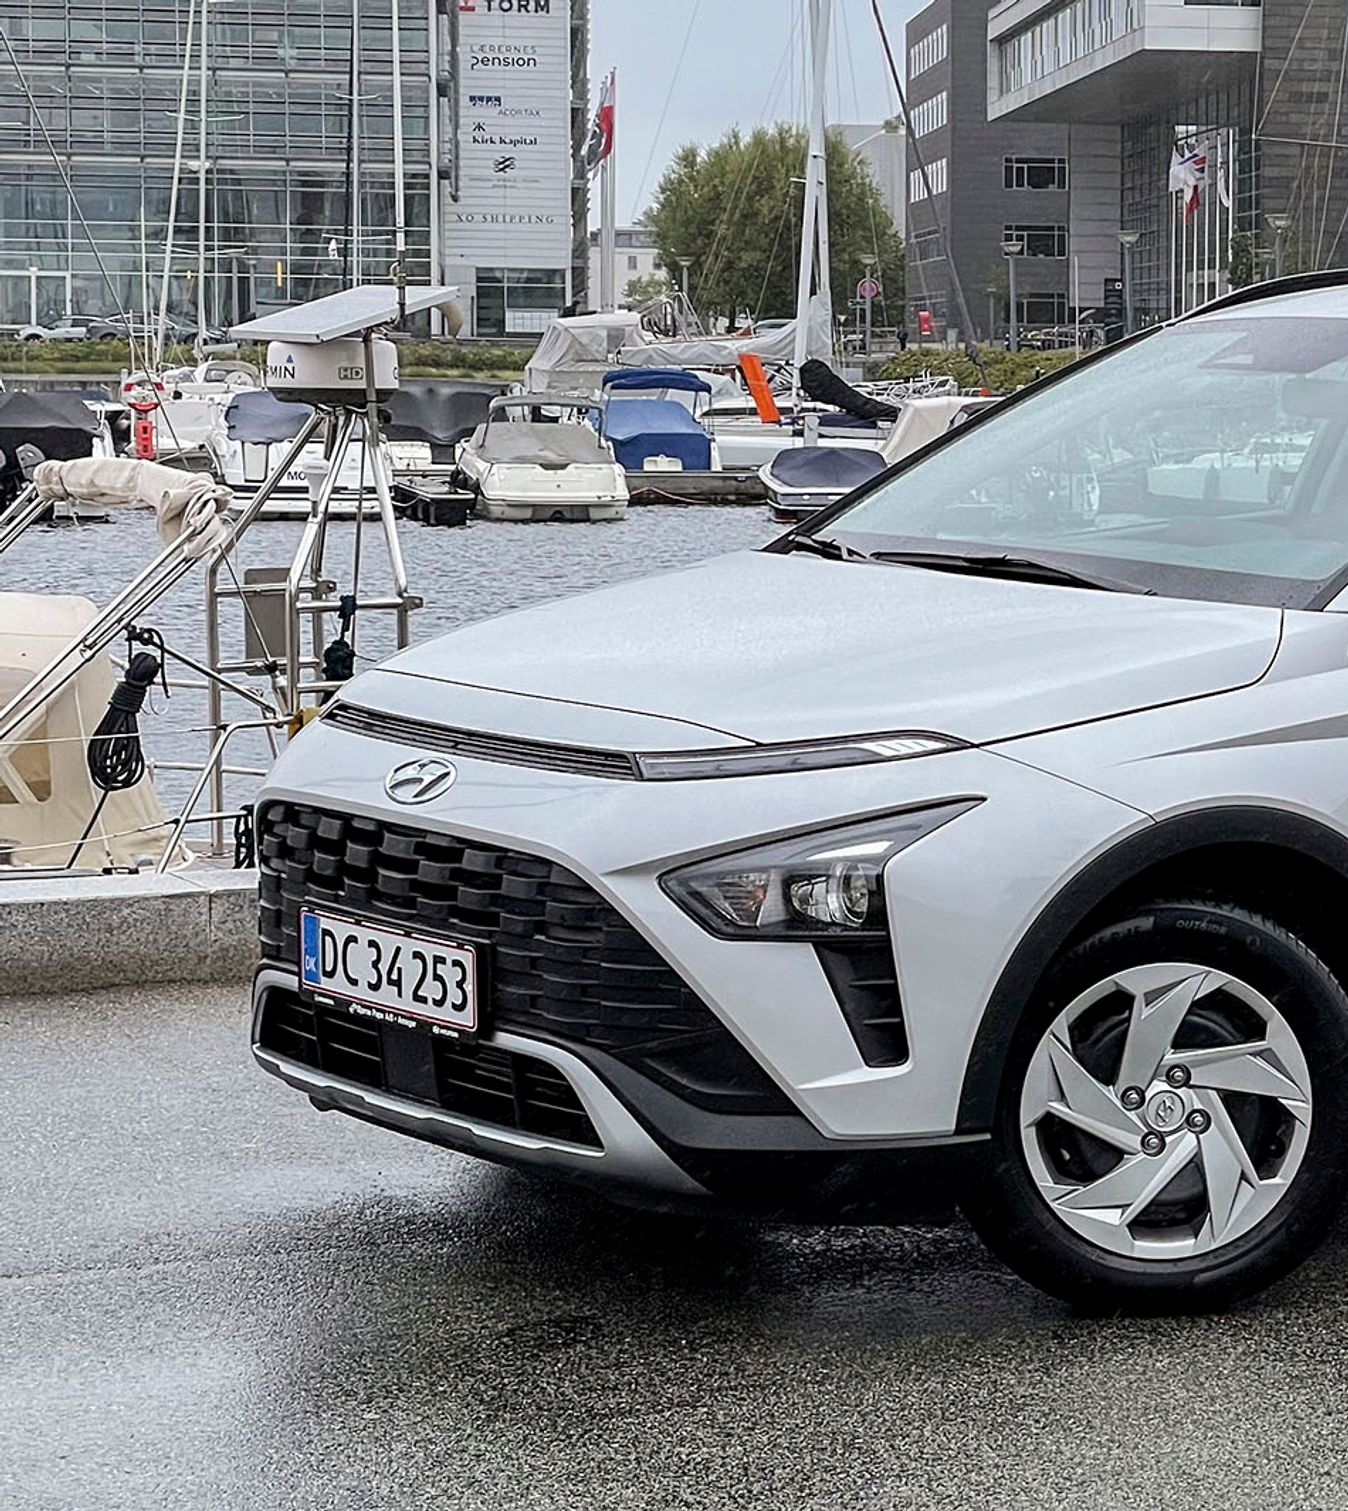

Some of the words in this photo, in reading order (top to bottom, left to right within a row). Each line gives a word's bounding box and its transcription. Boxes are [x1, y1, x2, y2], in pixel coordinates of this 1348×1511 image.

[471, 56, 537, 70] pension
[482, 214, 554, 224] SHIPPING
[266, 365, 295, 379] MIN
[340, 368, 363, 380] HD
[305, 957, 317, 973] DK
[321, 927, 359, 987] DC
[367, 939, 403, 999] 34
[411, 950, 468, 1012] 253
